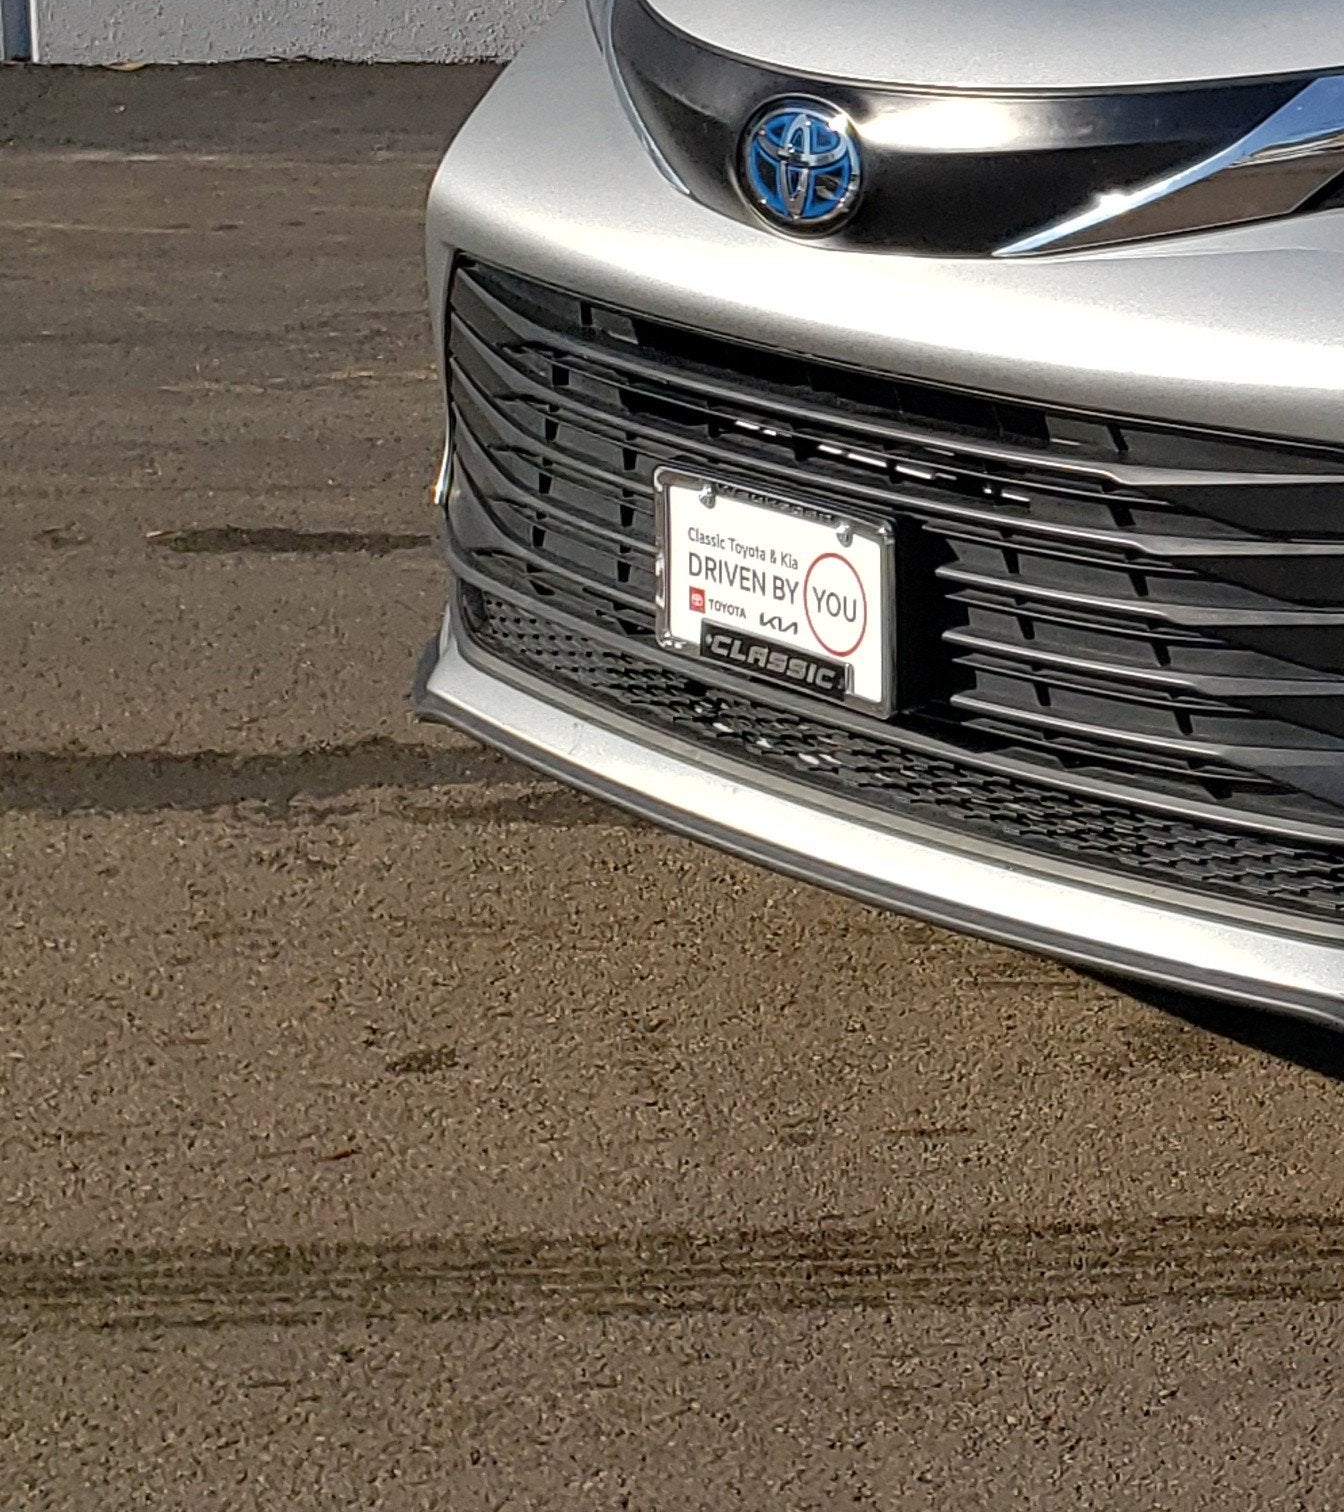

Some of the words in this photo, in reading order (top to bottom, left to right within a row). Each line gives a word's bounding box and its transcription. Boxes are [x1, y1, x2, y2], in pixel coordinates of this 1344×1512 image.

[688, 527, 726, 550] Classic
[728, 537, 766, 562] Toyota
[769, 549, 777, 564] &
[781, 552, 798, 570] Kia
[688, 552, 766, 597] DRIVEN
[773, 576, 799, 604] BY
[812, 586, 857, 623] YOU
[708, 598, 746, 619] TOYOTA
[710, 635, 836, 690] CLASSIC
